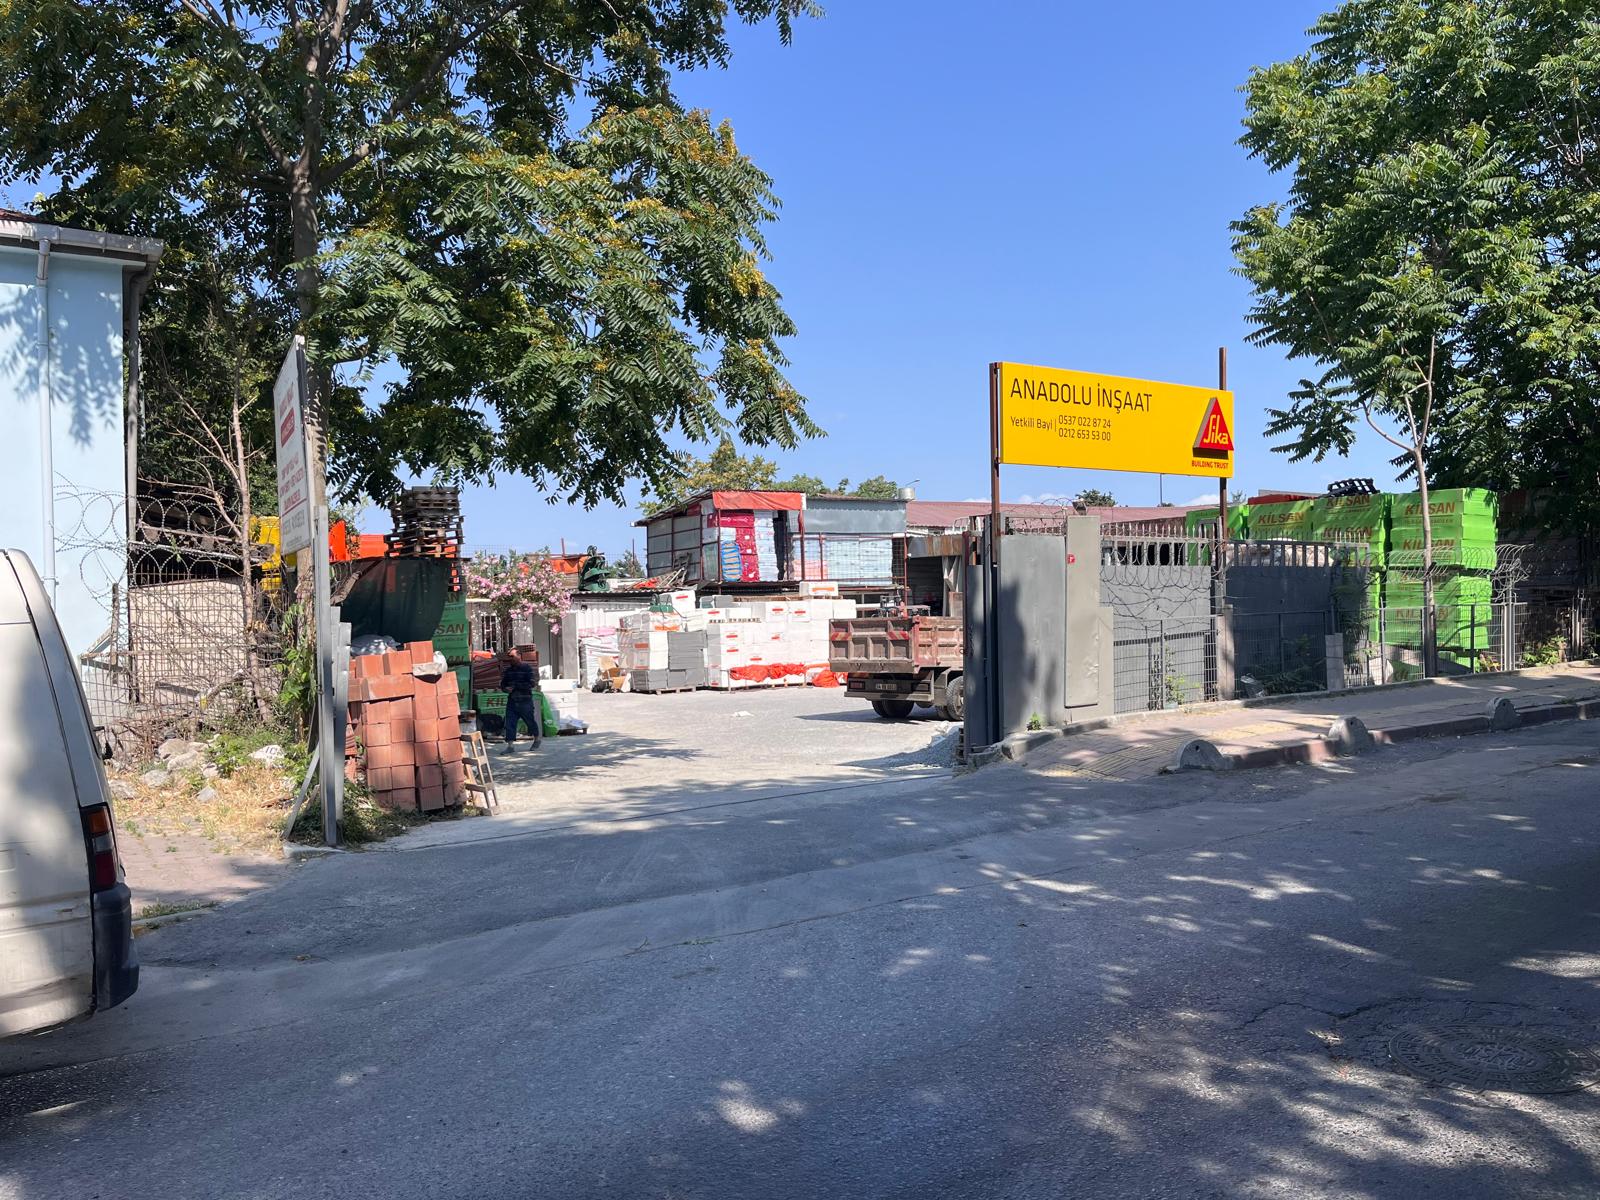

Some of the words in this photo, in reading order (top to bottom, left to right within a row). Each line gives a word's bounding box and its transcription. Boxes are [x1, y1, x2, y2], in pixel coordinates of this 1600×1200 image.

[1010, 377, 1092, 406] ANADOLU
[1097, 382, 1153, 414] İNŞAAT
[1010, 416, 1035, 428] Yetkili
[1036, 418, 1053, 431] Bayi
[1058, 414, 1077, 426] 0537
[1077, 416, 1091, 427] 022
[1092, 418, 1101, 428] 87
[1102, 419, 1111, 429] 24
[1203, 414, 1229, 444] Sika
[1058, 427, 1076, 438] 0212
[1077, 429, 1090, 440] 653
[1091, 430, 1100, 440] 53
[1101, 431, 1111, 441] 00
[1191, 459, 1213, 468] BUILDING
[1214, 461, 1229, 469] TRUST
